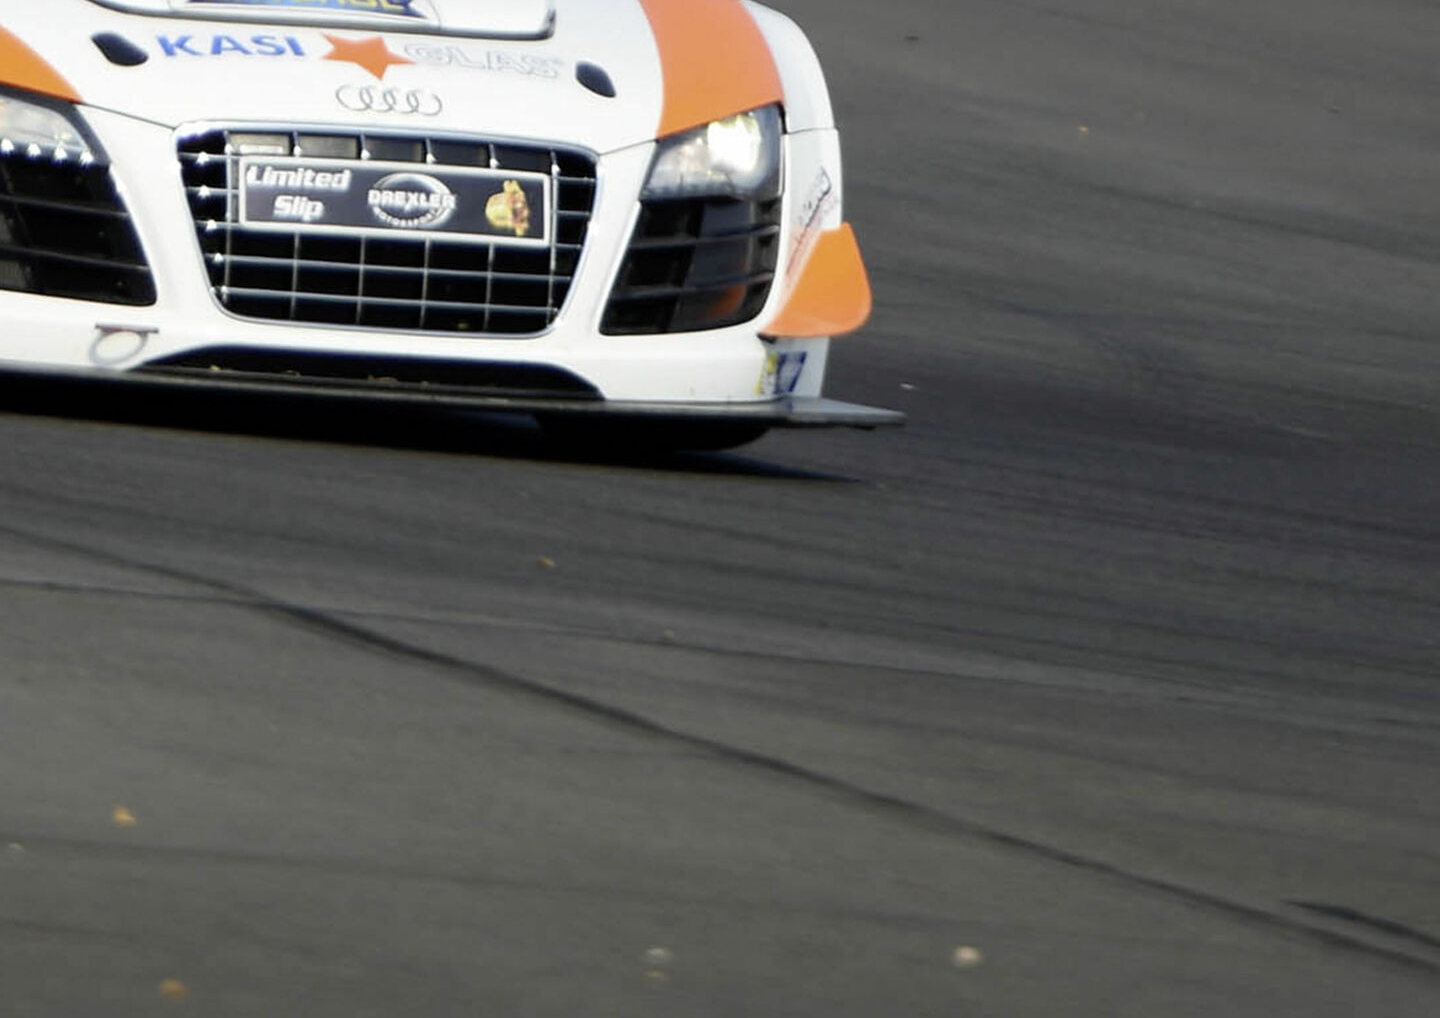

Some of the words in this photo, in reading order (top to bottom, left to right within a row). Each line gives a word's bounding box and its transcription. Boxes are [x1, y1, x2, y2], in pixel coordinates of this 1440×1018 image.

[156, 35, 306, 58] KASI
[404, 42, 565, 79] GLAS
[246, 166, 352, 190] Limited
[272, 195, 325, 222] Slip
[367, 189, 457, 209] DREXLER
